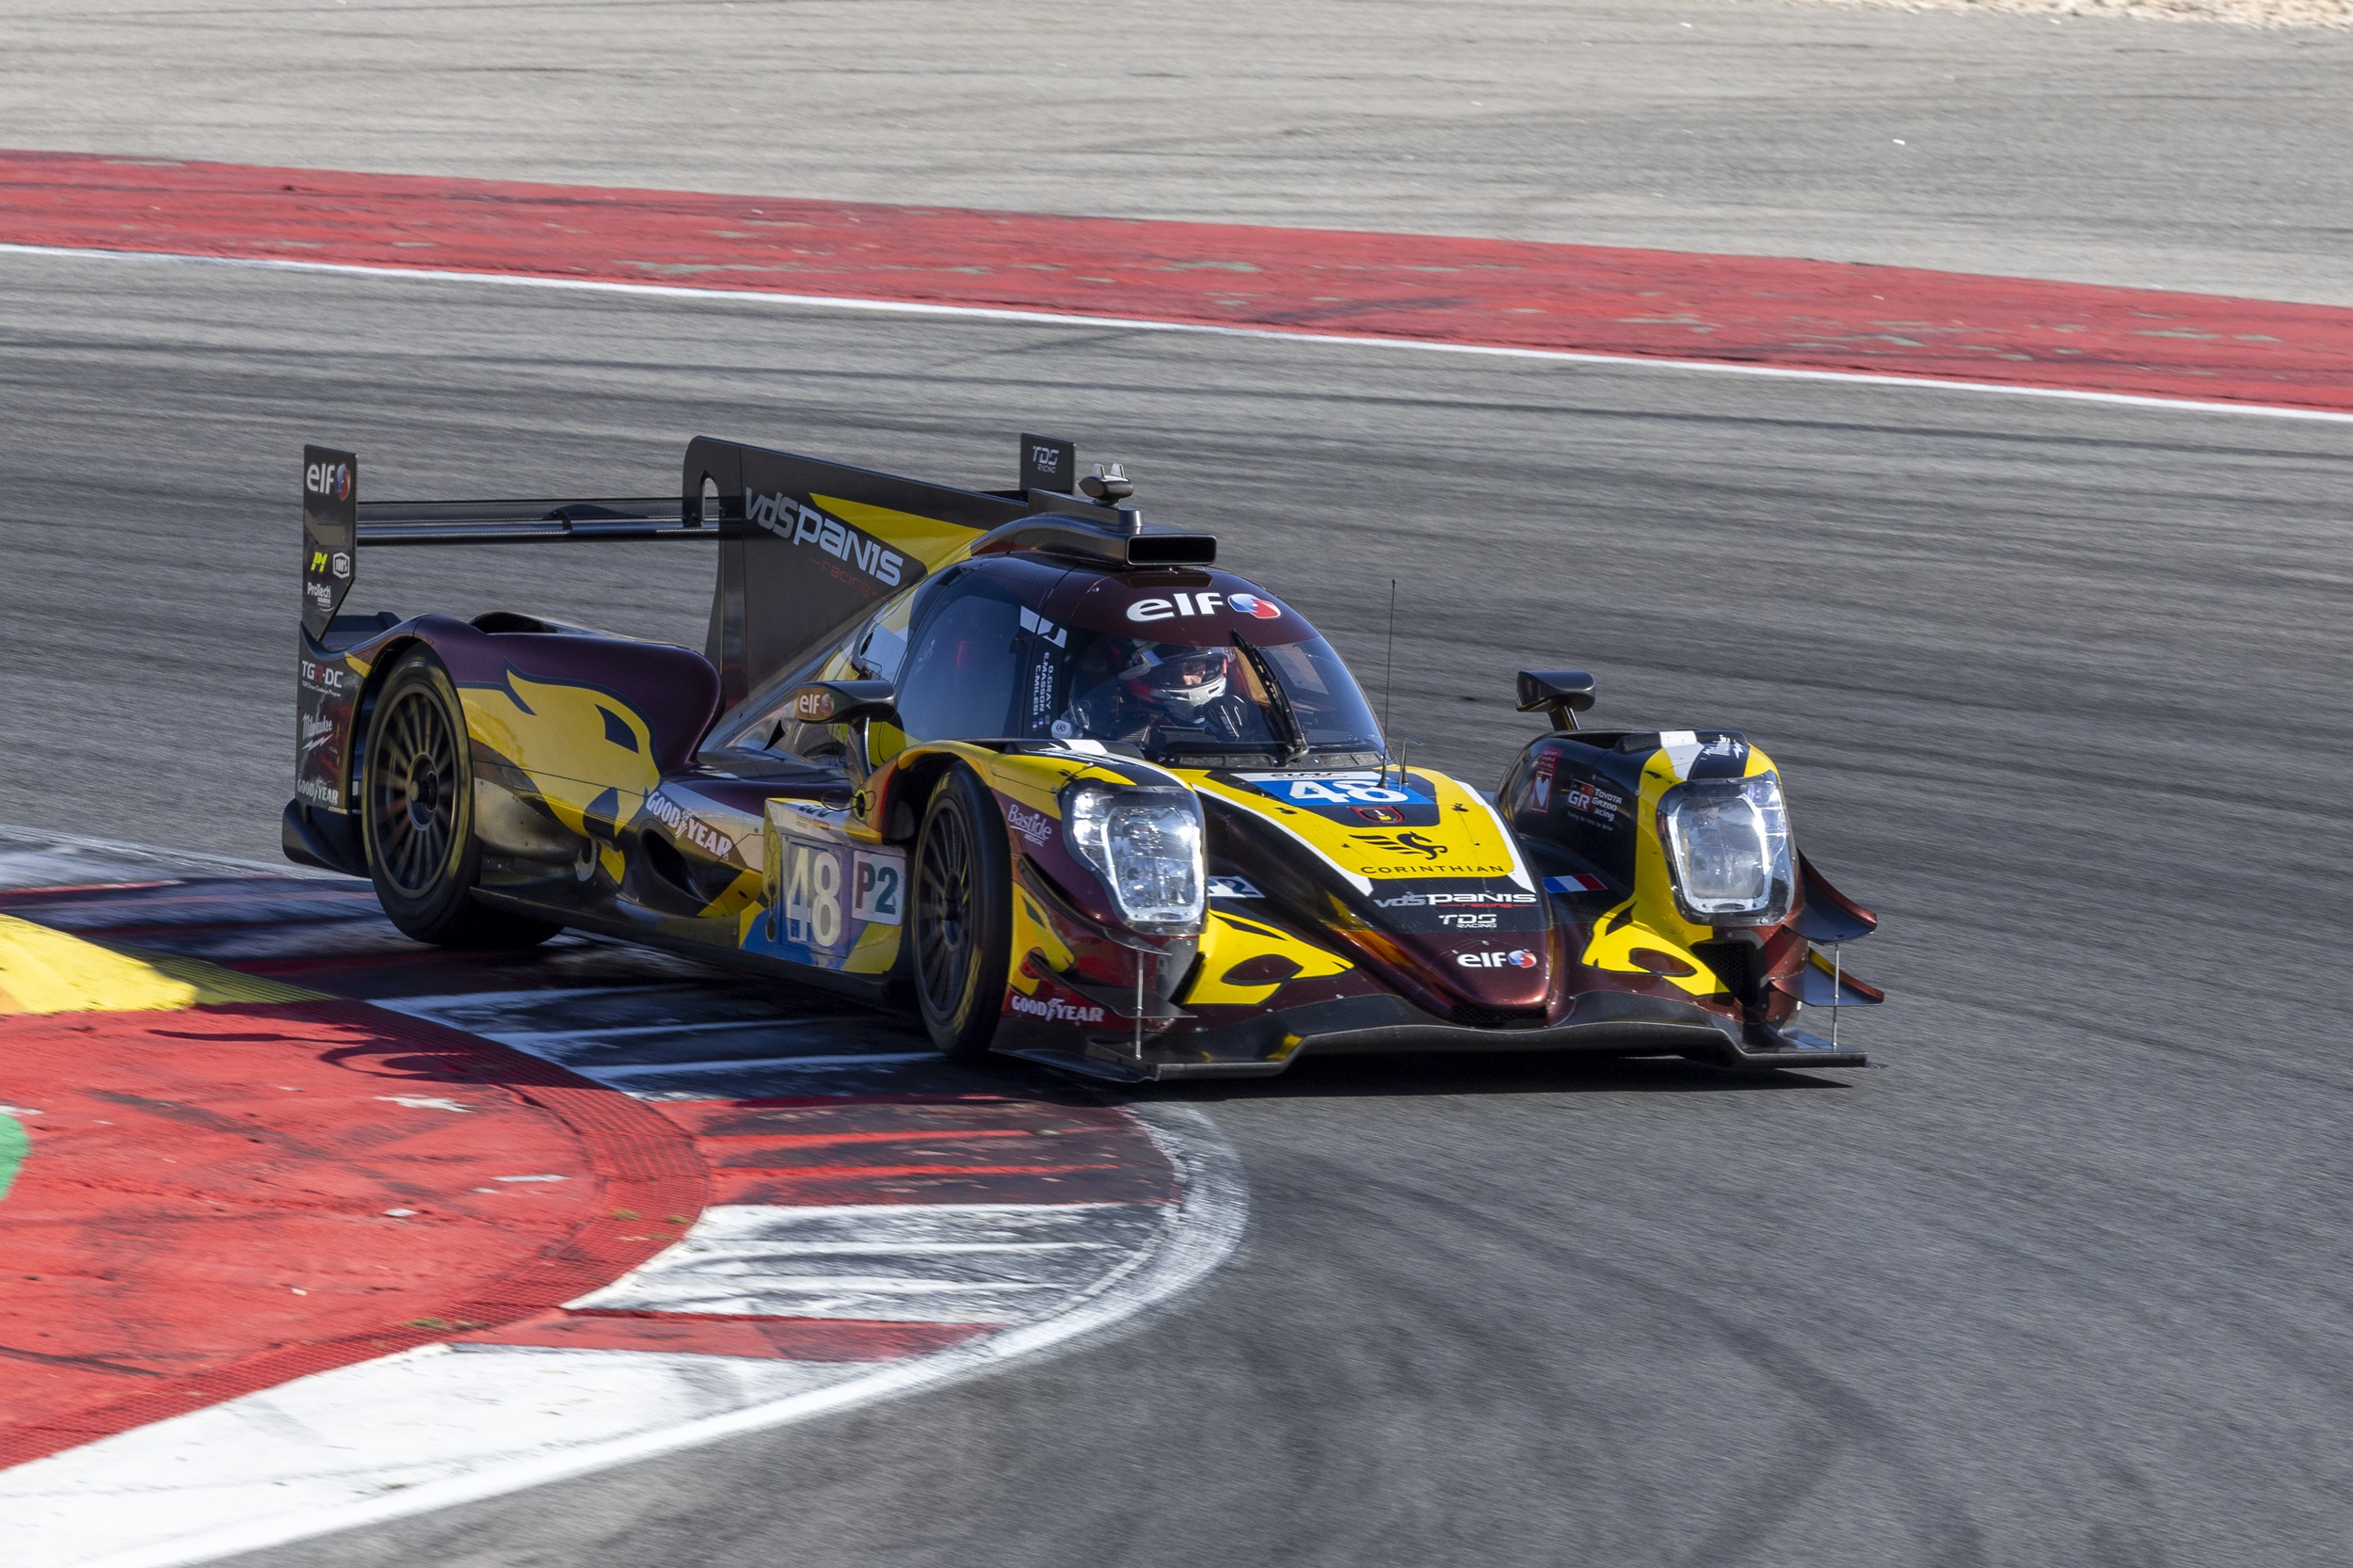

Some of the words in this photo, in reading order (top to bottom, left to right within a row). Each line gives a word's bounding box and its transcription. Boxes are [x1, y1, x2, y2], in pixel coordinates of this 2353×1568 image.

[306, 463, 336, 494] elf
[311, 552, 328, 573] P1
[307, 582, 331, 598] ProTech
[1127, 592, 1224, 622] elf
[799, 694, 821, 714] elf
[1289, 780, 1409, 803] 48
[1567, 790, 1590, 809] GR
[1594, 788, 1622, 804] TOYOTA
[646, 791, 733, 858] GOODYEAR
[1008, 804, 1052, 840] Bastide
[1360, 865, 1505, 874] CORINTHIAN
[786, 847, 841, 947] 48
[856, 861, 899, 915] P2
[1438, 913, 1497, 925] TDS
[1456, 952, 1507, 968] elf
[1011, 995, 1105, 1022] GOODYEAR
